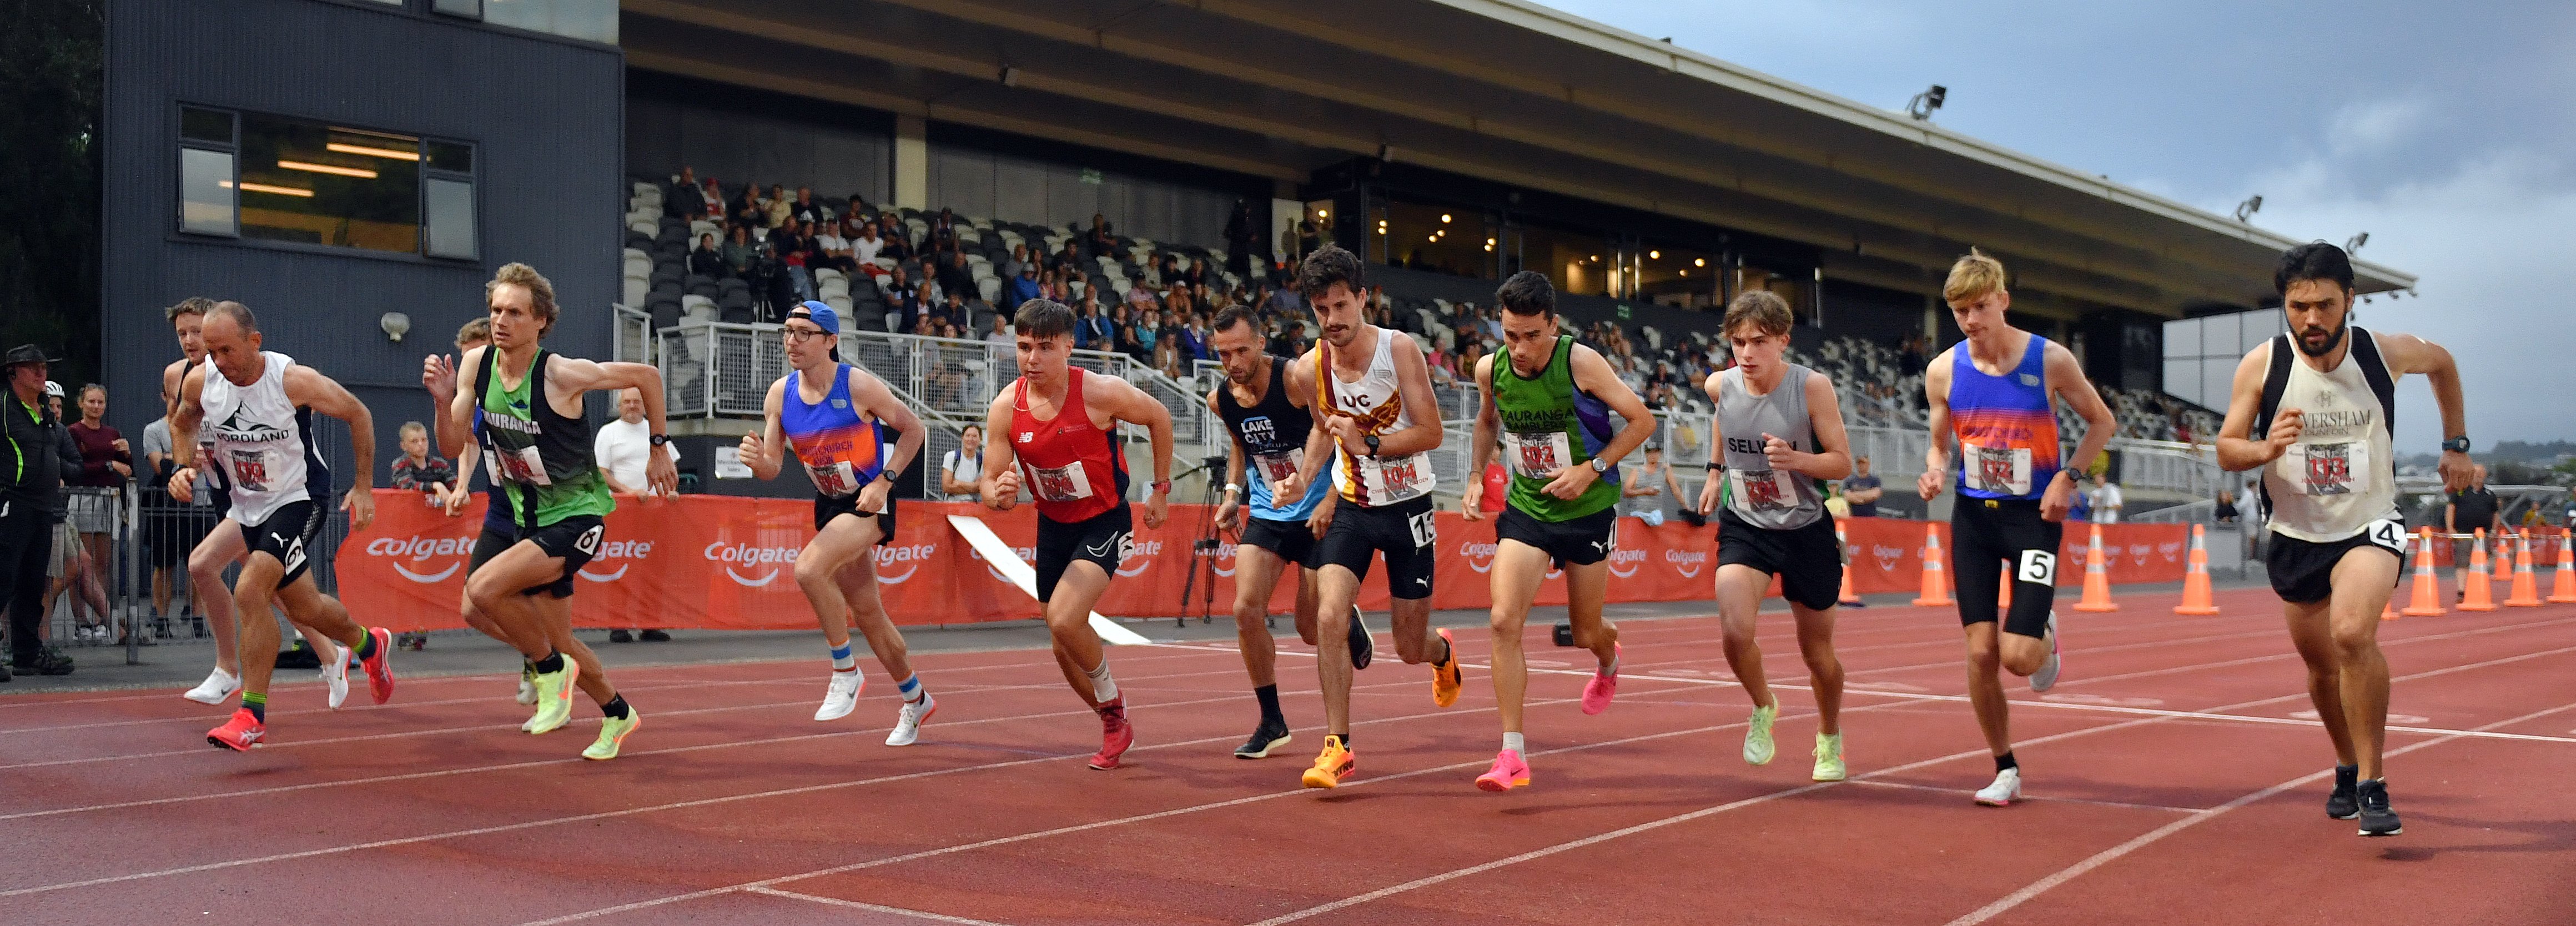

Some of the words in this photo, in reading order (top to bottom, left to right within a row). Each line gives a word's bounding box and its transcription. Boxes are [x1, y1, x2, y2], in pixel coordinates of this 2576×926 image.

[1343, 394, 1371, 407] UC
[1241, 419, 1274, 433] LAKE
[2305, 427, 2348, 436] DUNEDIN
[1245, 431, 1275, 444] CITY
[1521, 445, 1556, 465] 102
[236, 460, 263, 482] 110
[1382, 463, 1417, 486] 104
[1983, 460, 2013, 484] 112
[2310, 456, 2347, 478] 113
[1414, 511, 1434, 542] 13
[2377, 524, 2399, 546] 4
[705, 541, 798, 567] Colgate
[2028, 553, 2047, 579] 5
